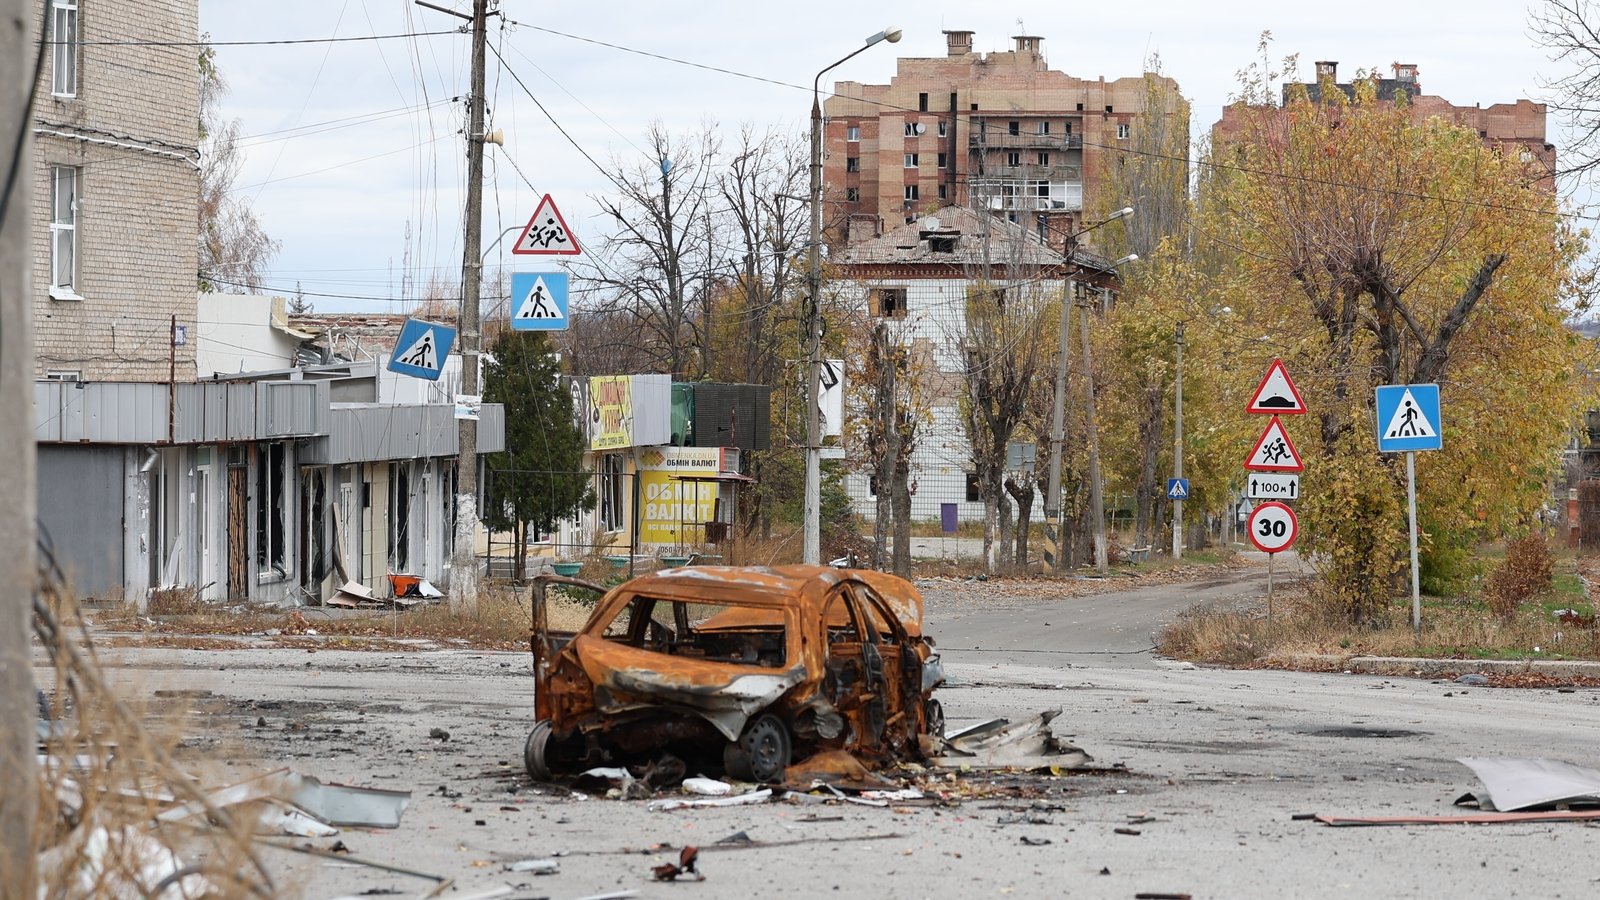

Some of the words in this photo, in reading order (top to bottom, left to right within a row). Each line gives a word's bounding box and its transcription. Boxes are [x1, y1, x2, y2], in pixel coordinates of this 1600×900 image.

[666, 459, 690, 467] ОБМІН
[691, 459, 717, 467] ВАЛЮТ
[646, 483, 711, 501] ОБМІН
[646, 503, 710, 521] ВАЛЮТ
[1258, 518, 1287, 538] 30
